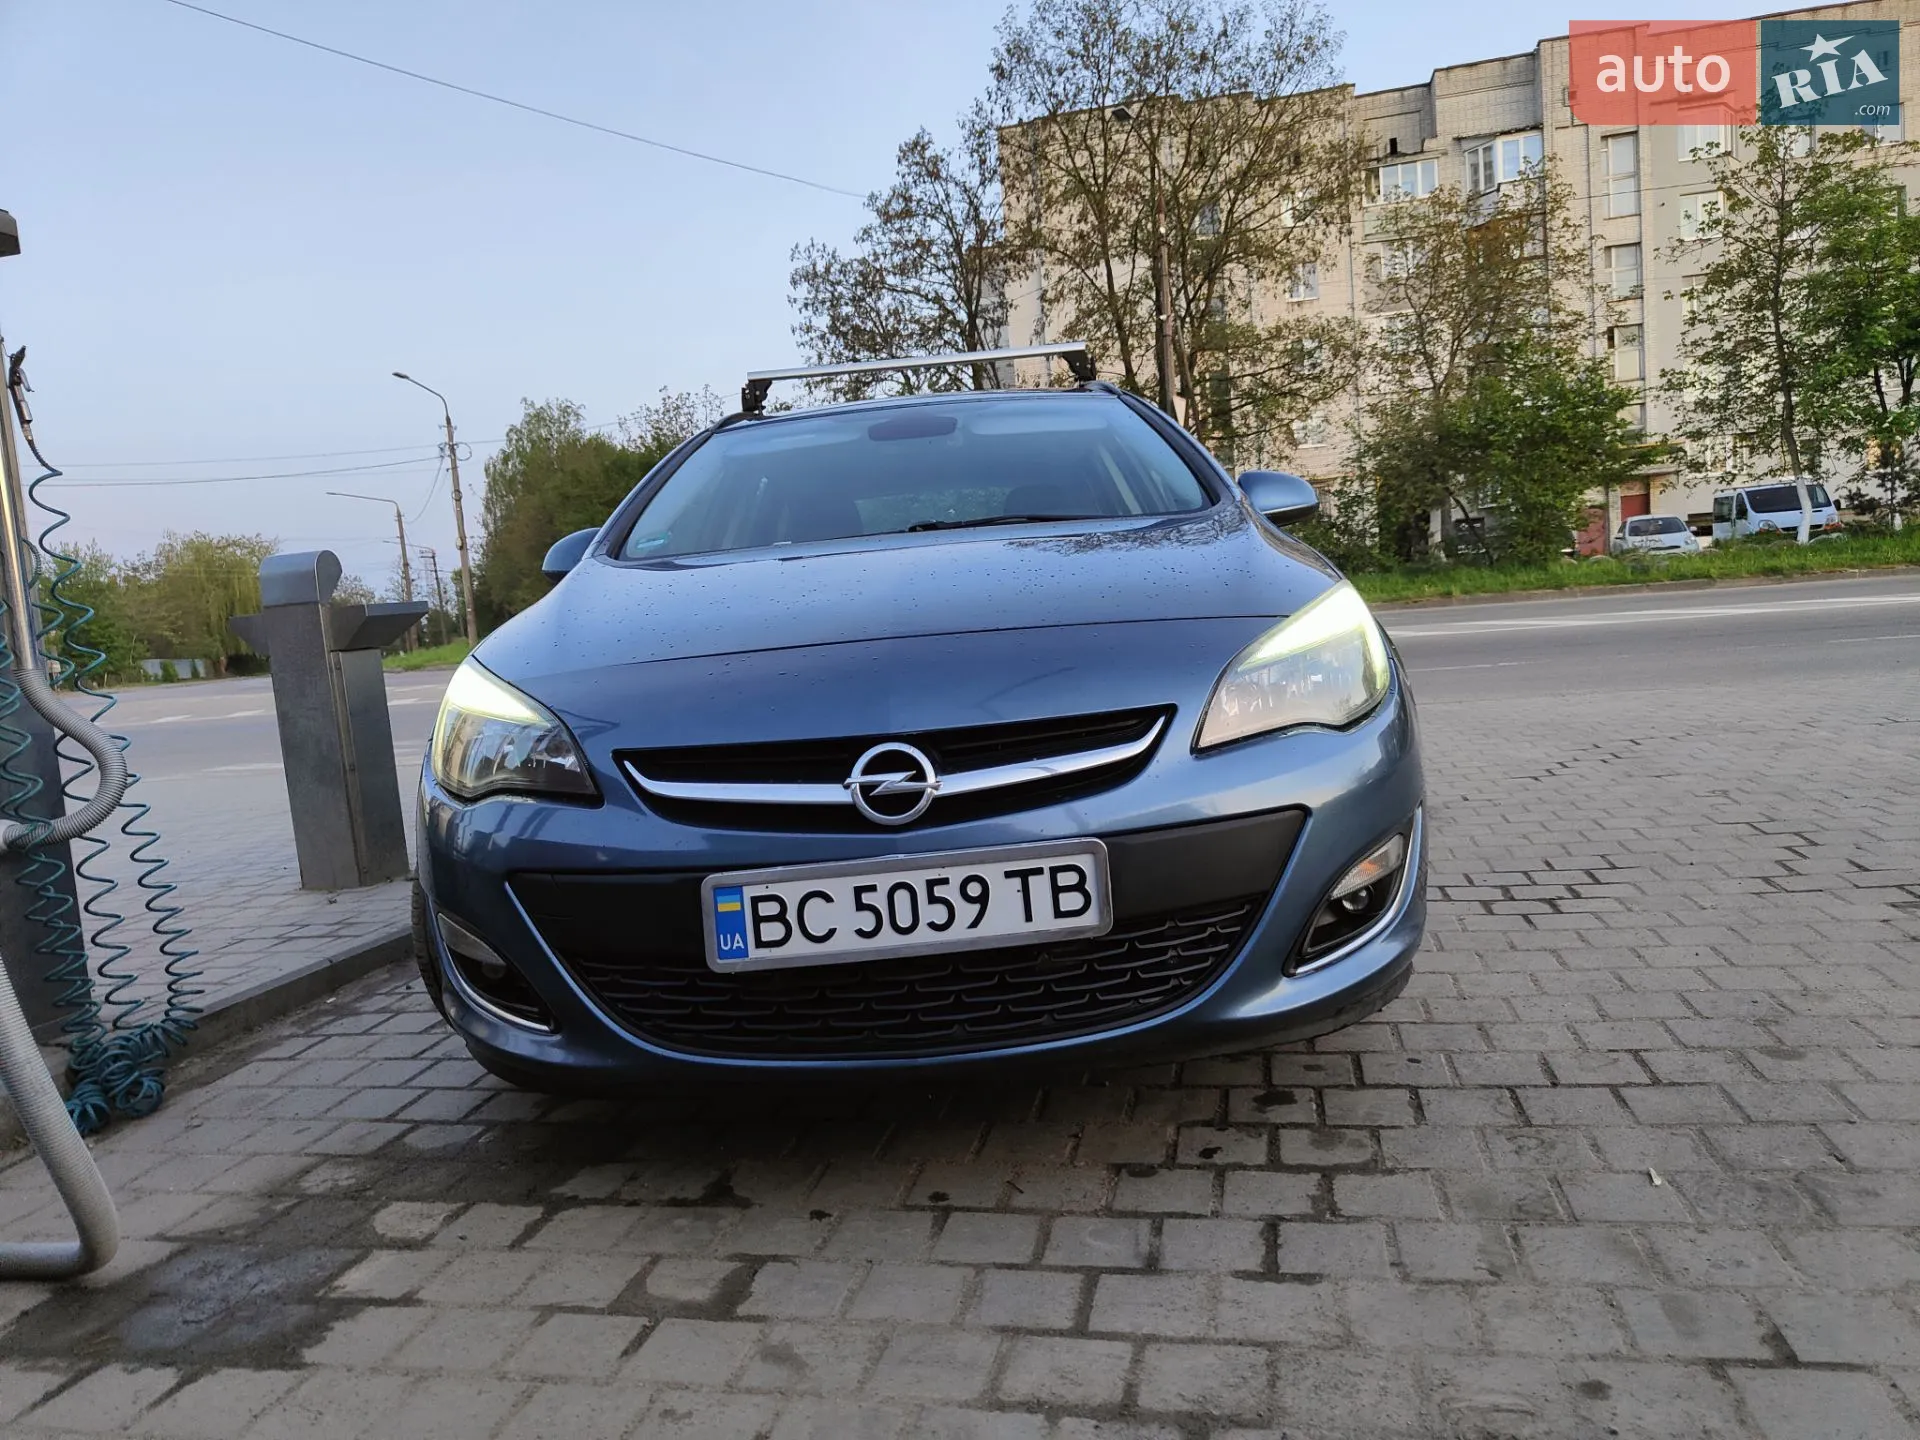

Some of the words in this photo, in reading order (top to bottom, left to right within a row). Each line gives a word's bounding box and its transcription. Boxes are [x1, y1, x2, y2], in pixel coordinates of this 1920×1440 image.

[750, 889, 838, 949] BC
[853, 874, 991, 940] 5059
[1003, 863, 1093, 924] TB
[720, 932, 744, 951] UA
